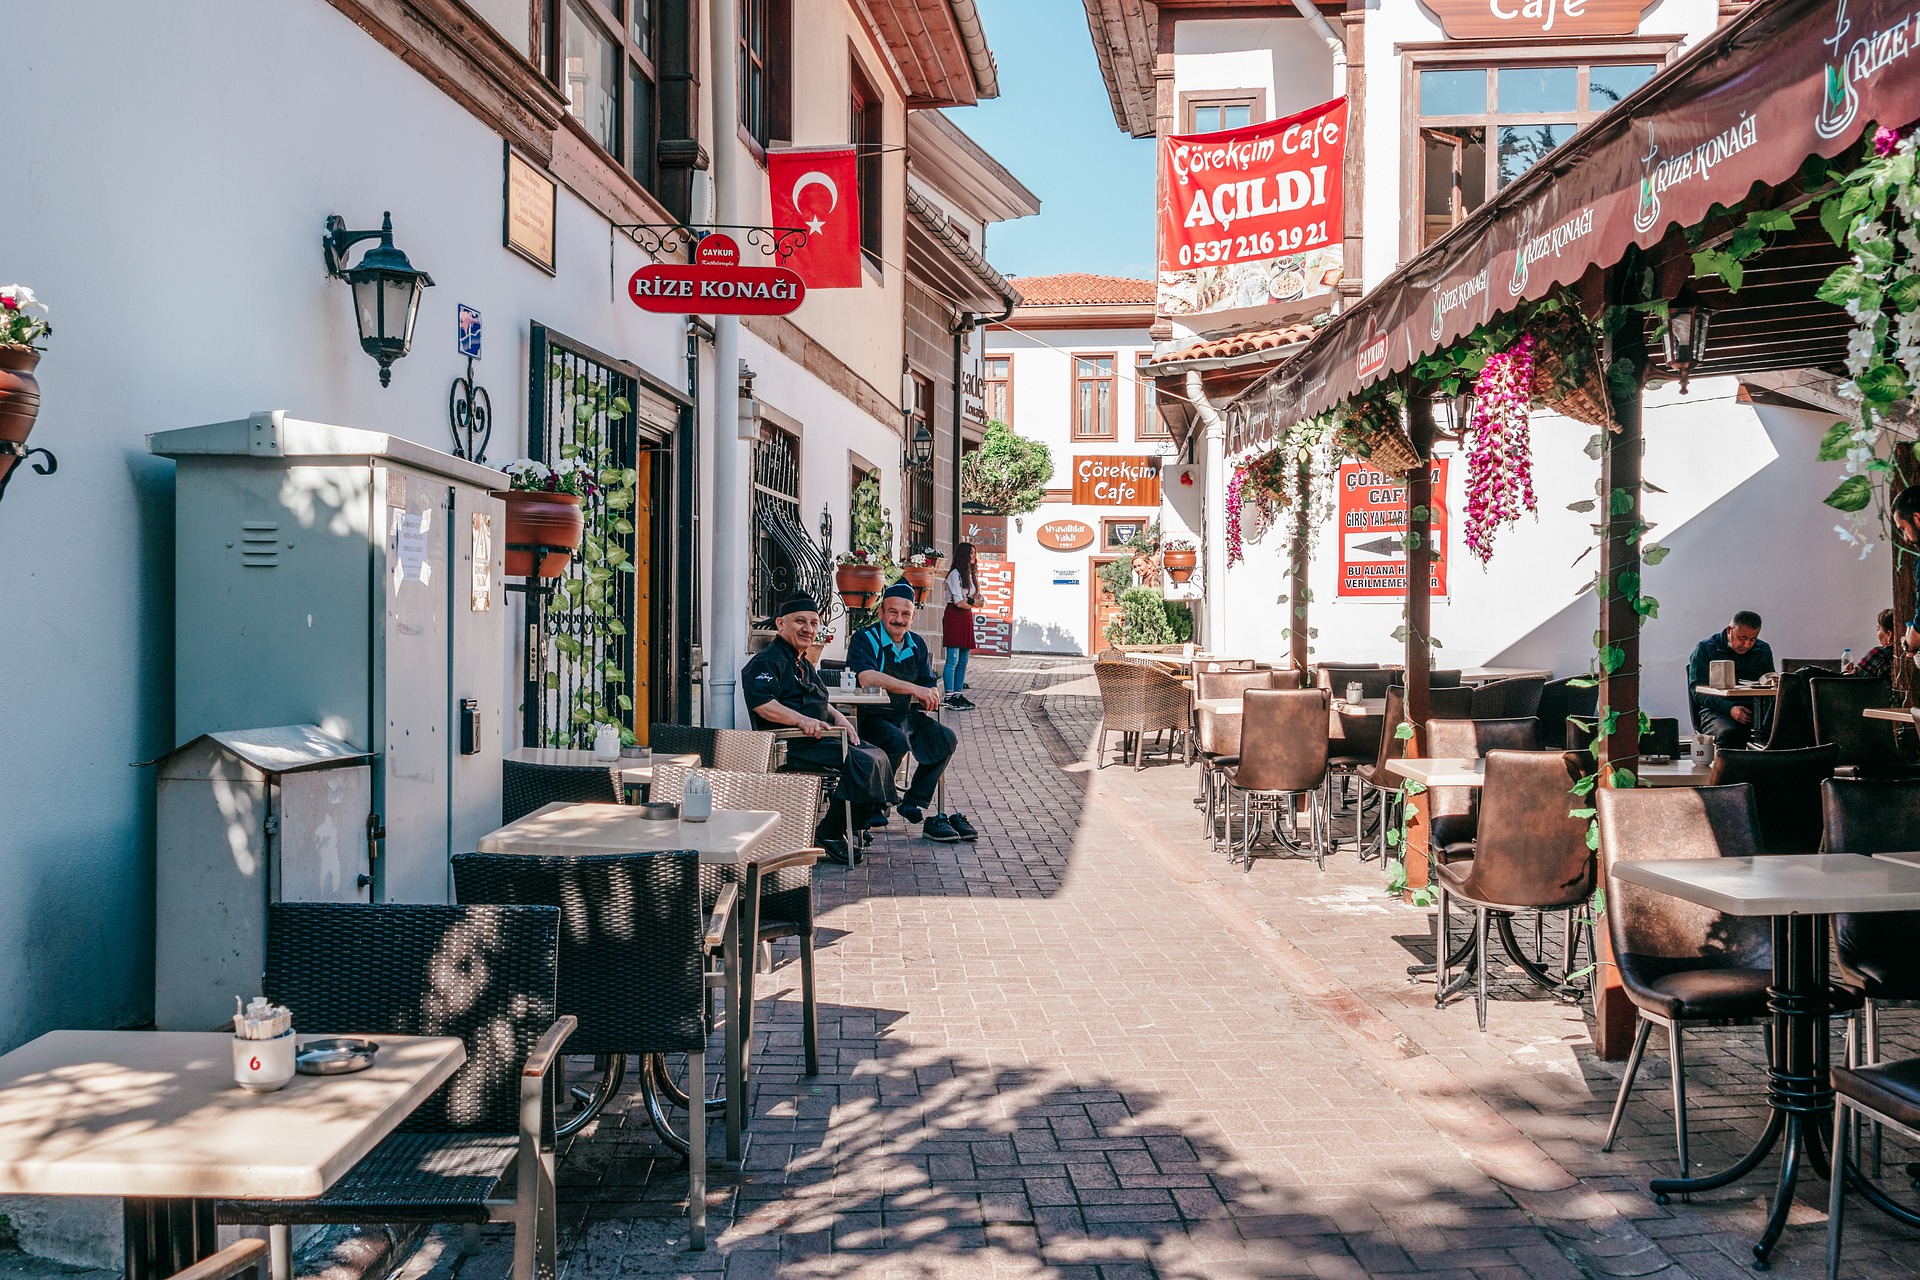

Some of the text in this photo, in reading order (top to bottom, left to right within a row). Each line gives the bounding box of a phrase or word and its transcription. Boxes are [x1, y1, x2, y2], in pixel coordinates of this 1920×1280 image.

[1173, 115, 1340, 185] Çörekçim Cafe
[1656, 110, 1758, 193] RİZE KONAĞI
[1183, 164, 1329, 232] AÇILDI
[1235, 230, 1275, 258] 216
[1277, 226, 1304, 251] 19
[1304, 220, 1329, 246] 21
[1526, 207, 1594, 265] RİZE KONAĞI
[635, 275, 798, 301] RİZE KONAĞI
[1441, 269, 1488, 315] RİZE KONAĞI
[1078, 460, 1157, 483] Çörekçim
[1094, 481, 1136, 505] Cafe
[1345, 508, 1368, 530] GİRİŞ
[1369, 512, 1386, 526] YAN
[1348, 566, 1361, 576] BU
[1364, 565, 1396, 576] ALANA
[249, 1055, 262, 1071] 6
